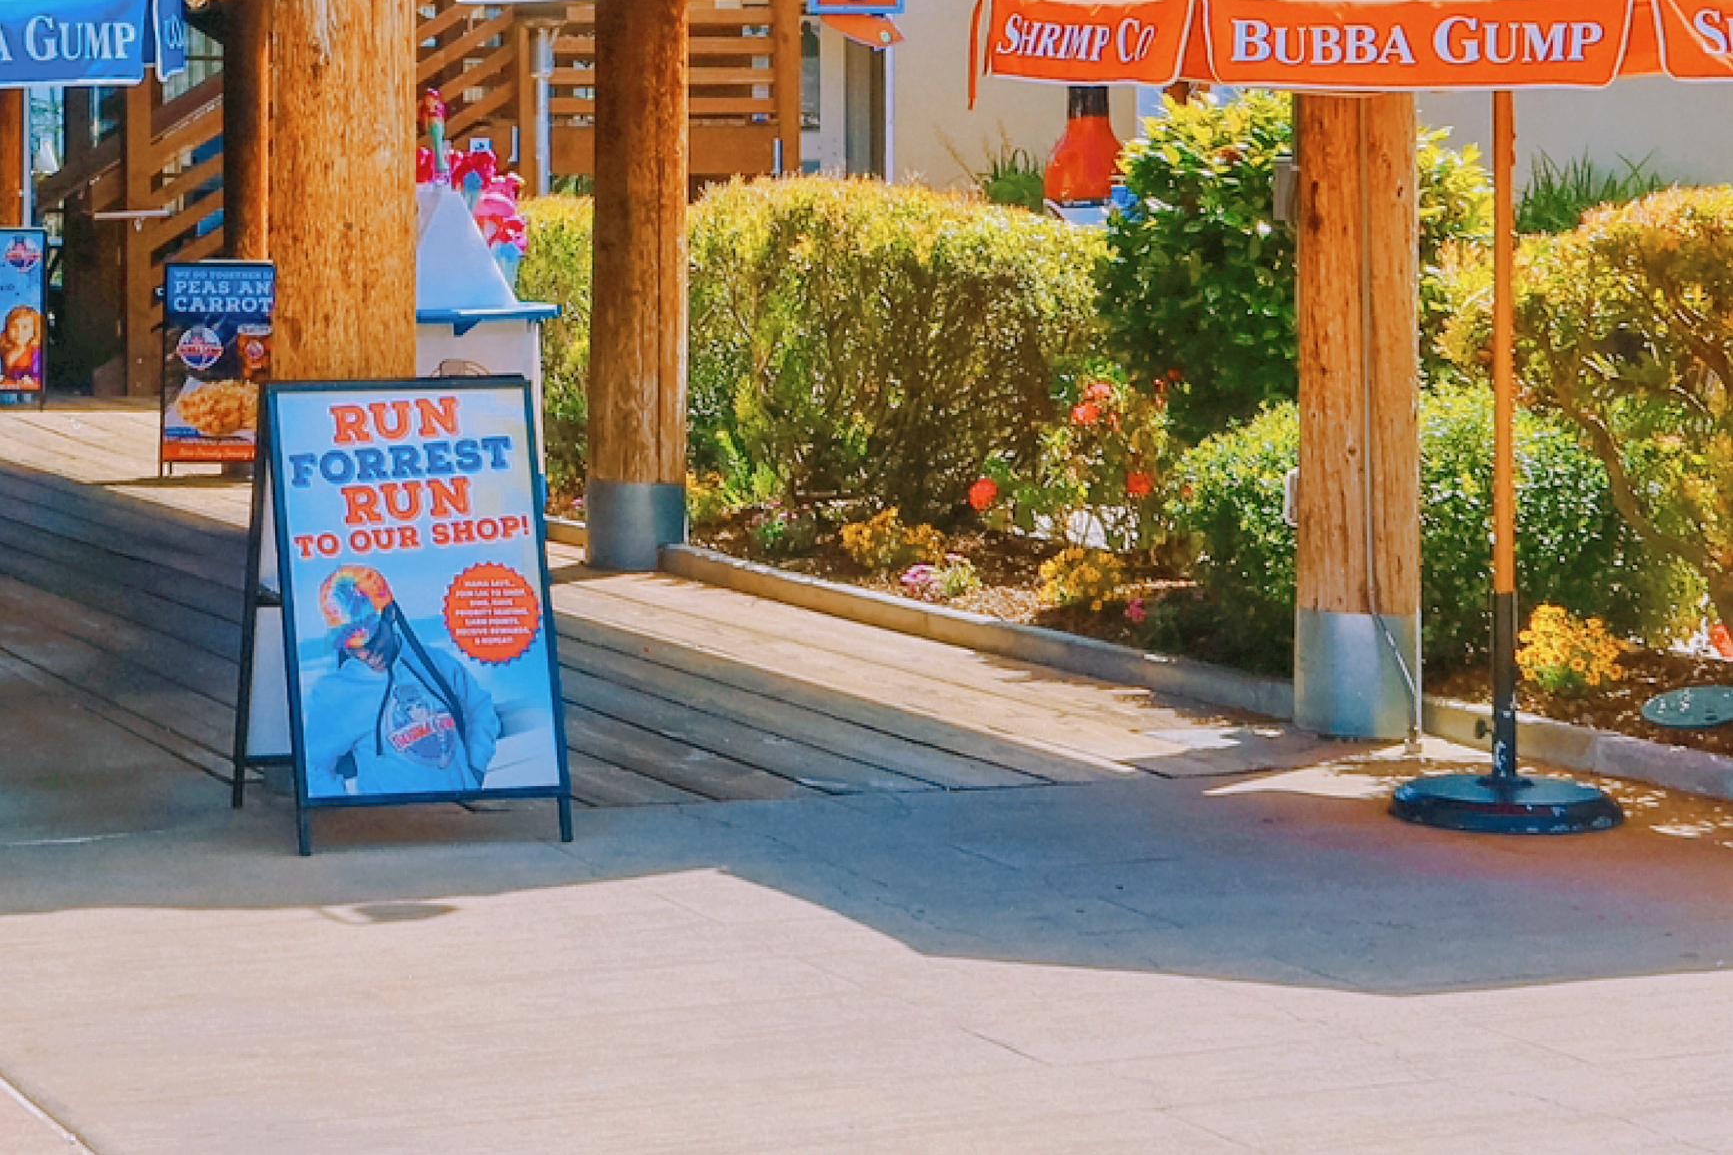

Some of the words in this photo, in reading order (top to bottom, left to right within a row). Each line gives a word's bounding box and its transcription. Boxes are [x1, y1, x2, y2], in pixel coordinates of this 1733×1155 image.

[25, 14, 136, 61] GUMP
[996, 13, 1110, 62] SHRIMP
[1230, 17, 1417, 65] BUBBA
[1433, 15, 1604, 65] GUMP
[1694, 8, 1733, 55] S
[174, 280, 230, 294] PEAS
[329, 395, 460, 445] RUN
[289, 436, 511, 488] FORREST
[341, 475, 471, 526] RUN
[294, 530, 341, 559] TO
[348, 525, 422, 554] OUR
[433, 514, 530, 546] SHOP!
